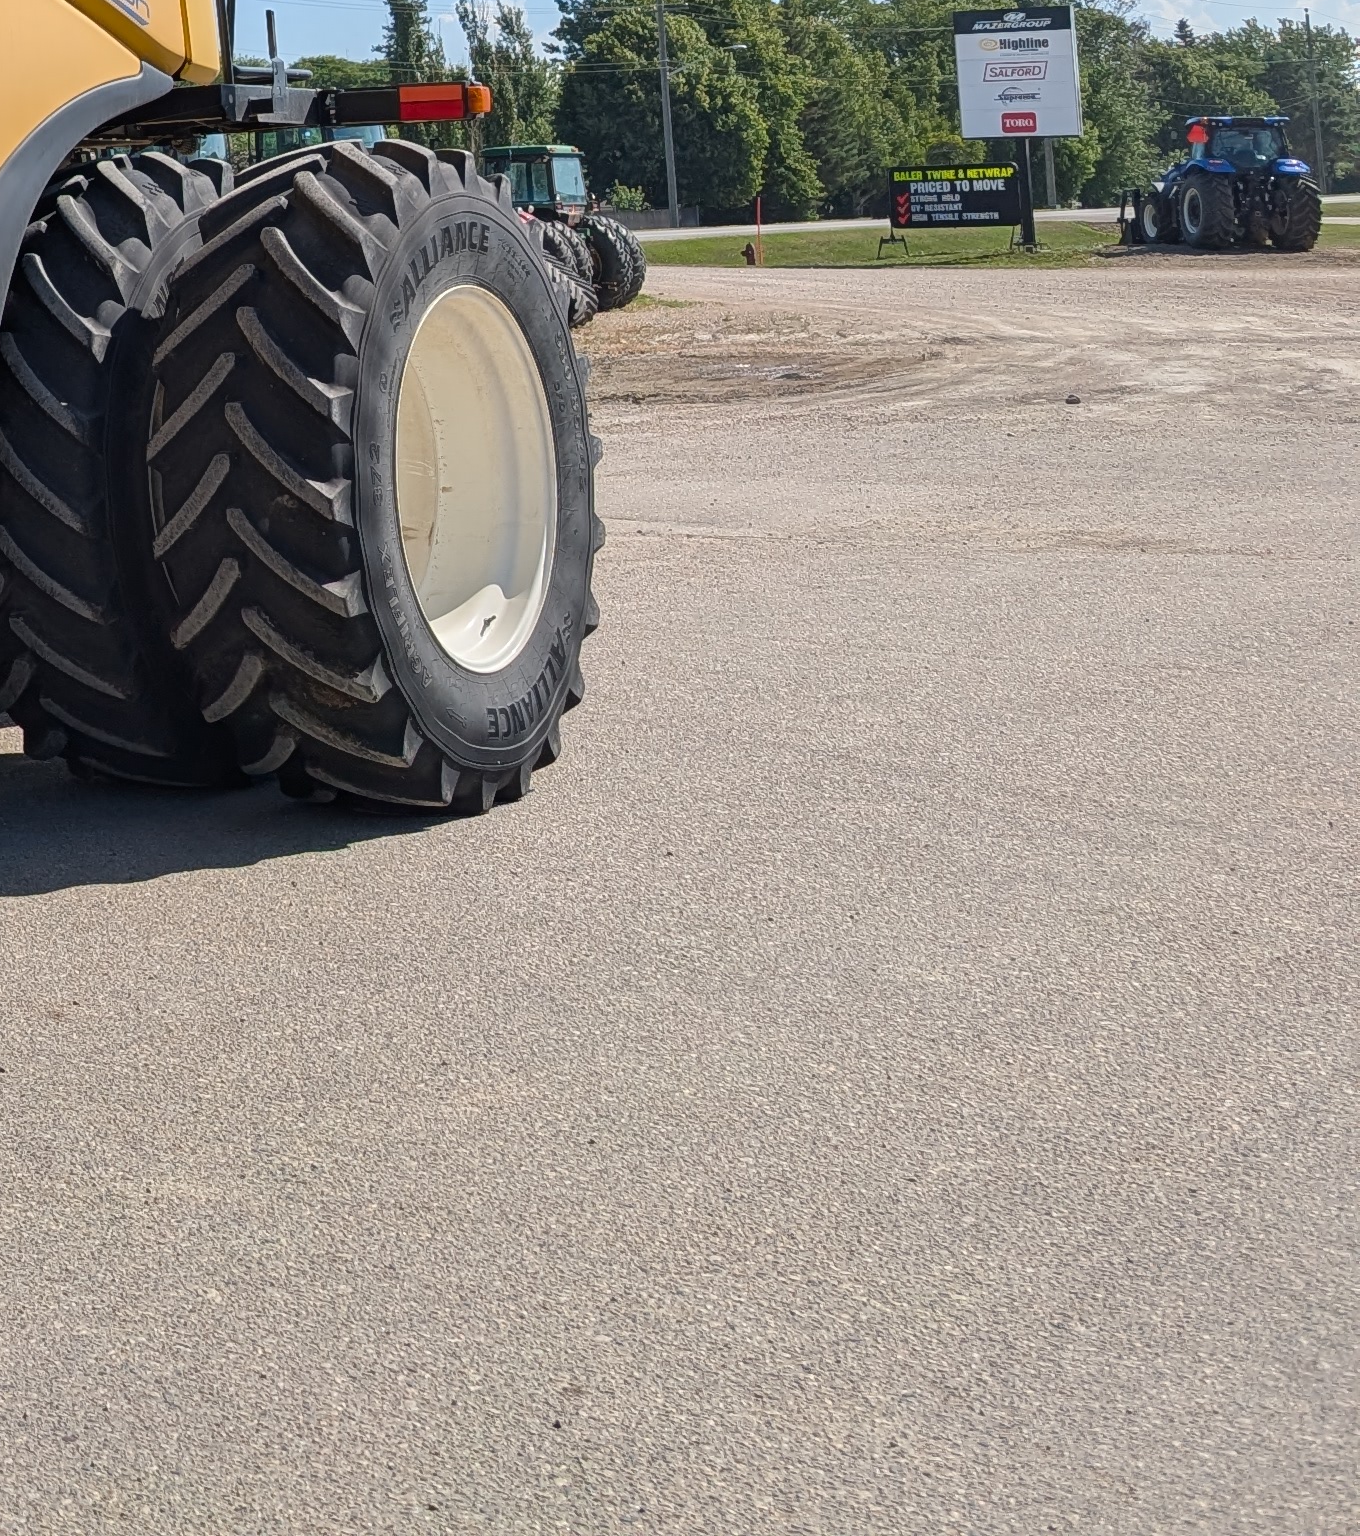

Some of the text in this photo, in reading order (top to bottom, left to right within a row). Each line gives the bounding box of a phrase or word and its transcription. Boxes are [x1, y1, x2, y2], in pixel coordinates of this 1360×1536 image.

[972, 20, 1052, 31] MAZERGROUP
[999, 37, 1049, 51] Highline
[989, 65, 1042, 78] SALFORD
[1004, 118, 1035, 128] TORO
[893, 170, 923, 182] BALER
[958, 168, 965, 179] &
[910, 179, 1006, 194] PRICED TO MOVE
[400, 220, 491, 321] ALLIANCE
[486, 627, 567, 741] ALLIANCE
